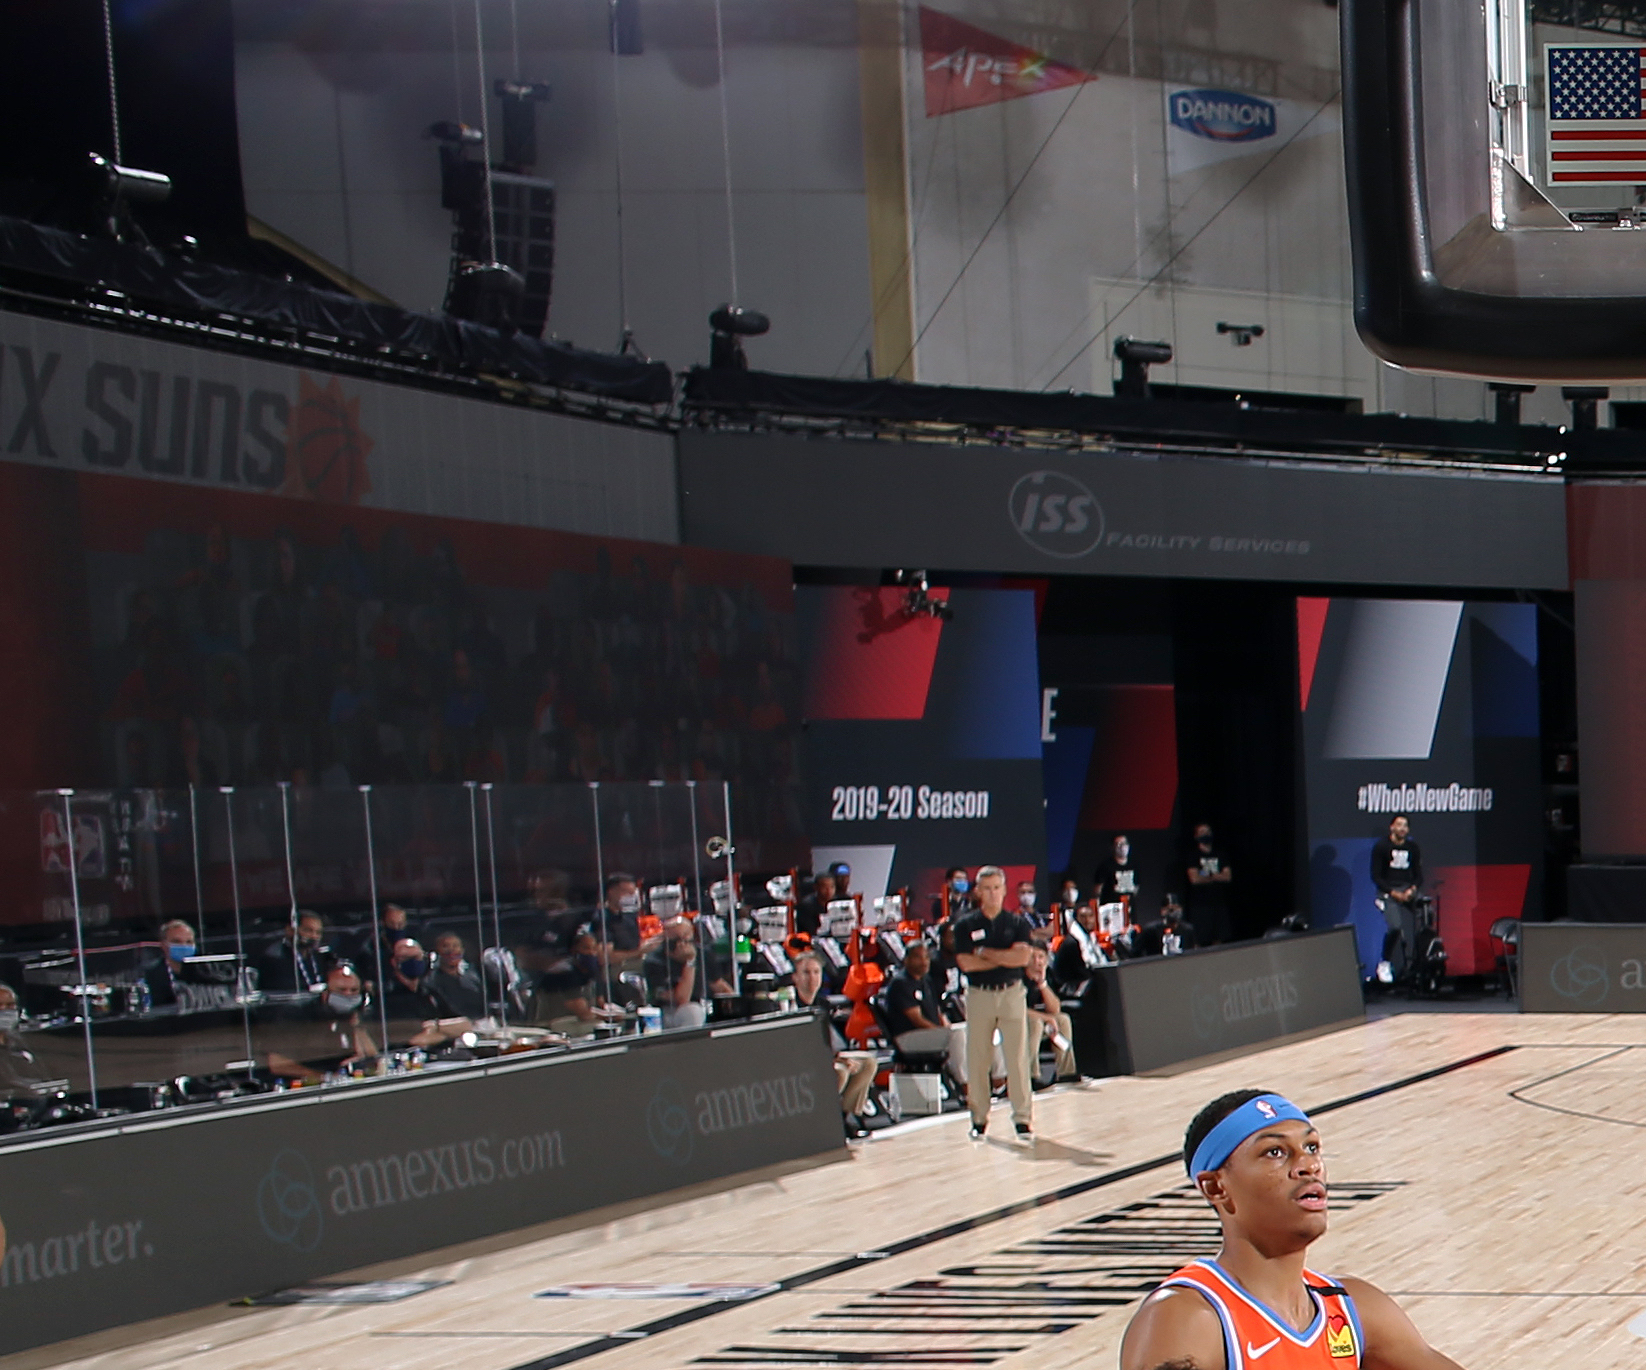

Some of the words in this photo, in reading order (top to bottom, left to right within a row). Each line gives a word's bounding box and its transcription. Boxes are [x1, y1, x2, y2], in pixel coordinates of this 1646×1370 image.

[1177, 98, 1272, 126] DANNON
[82, 361, 288, 490] SUNS
[1106, 532, 1200, 549] FACILITY
[1208, 535, 1311, 554] SERVICES
[831, 786, 912, 821] 2019-20
[917, 783, 990, 820] Season
[1357, 782, 1493, 813] #WholeNewGame
[695, 1072, 816, 1137] annexus
[328, 1127, 566, 1217] annexus.com
